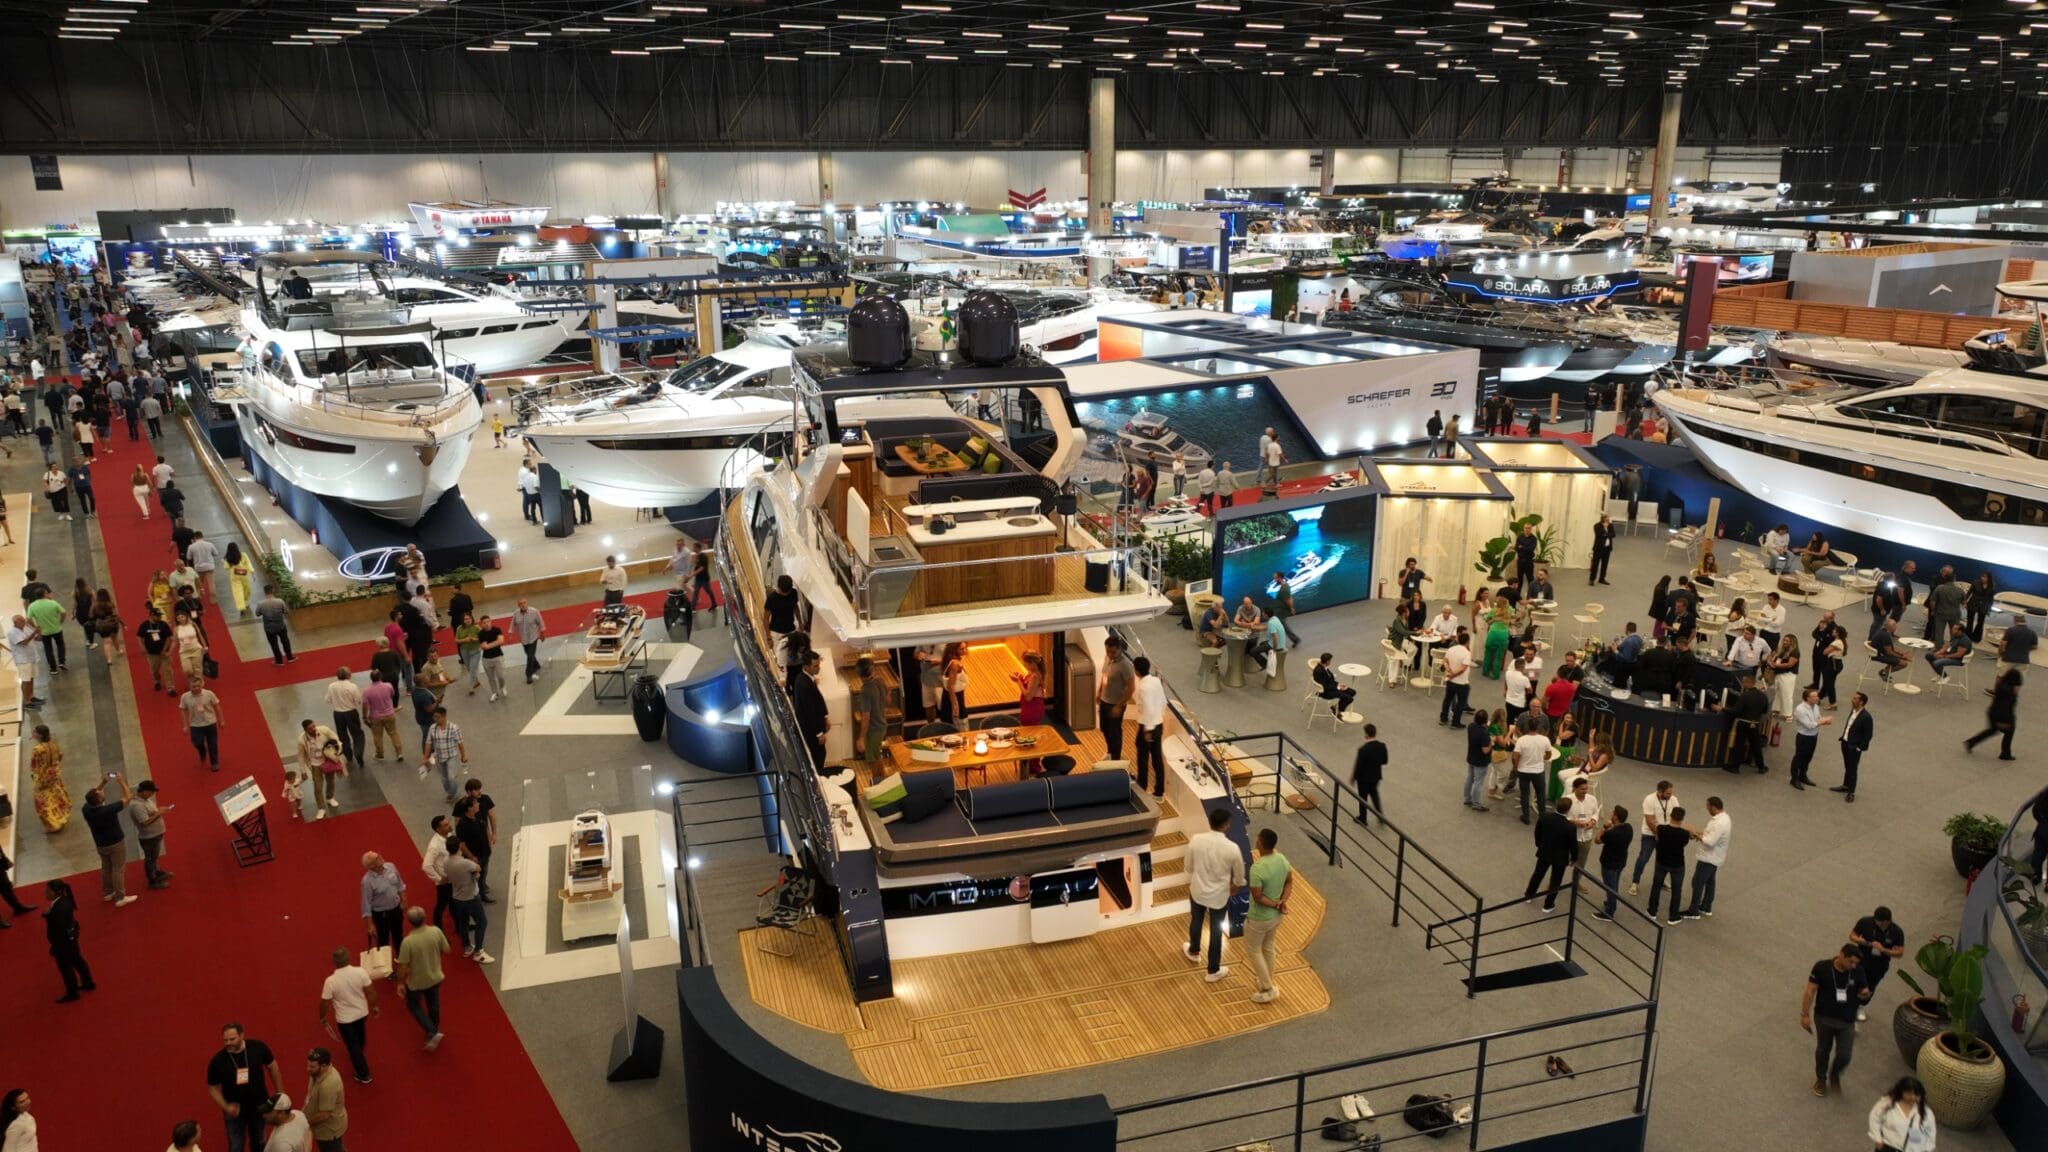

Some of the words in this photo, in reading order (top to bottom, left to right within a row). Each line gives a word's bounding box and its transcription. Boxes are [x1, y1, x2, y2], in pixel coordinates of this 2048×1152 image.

[480, 215, 512, 225] YAMAHA
[1495, 281, 1551, 294] SOLARA
[1571, 279, 1611, 293] SOLARA
[1347, 388, 1410, 404] SCHAEFER
